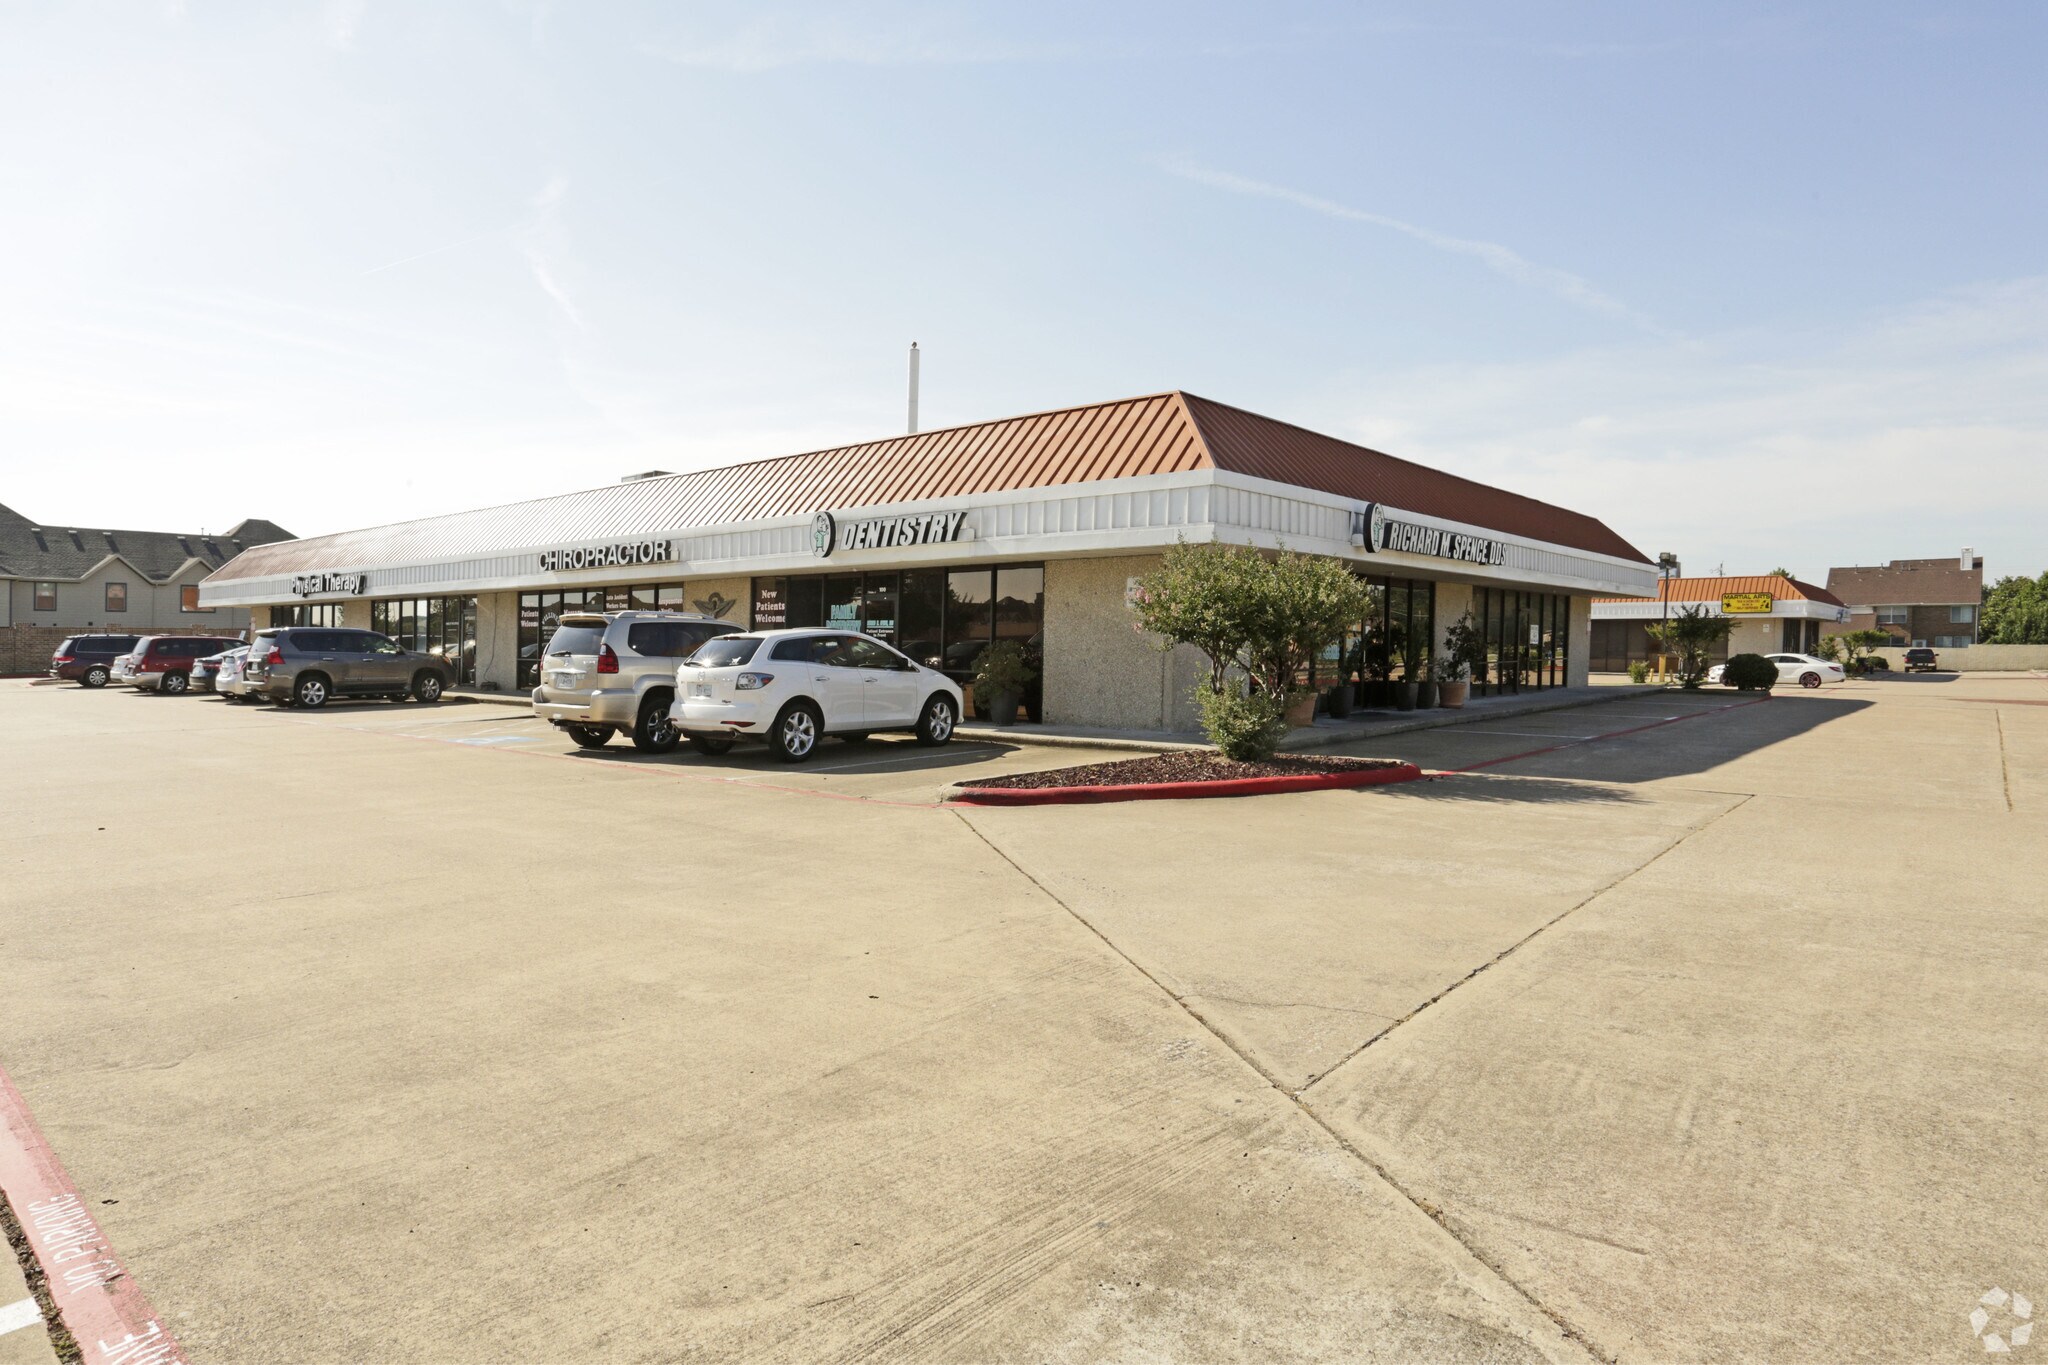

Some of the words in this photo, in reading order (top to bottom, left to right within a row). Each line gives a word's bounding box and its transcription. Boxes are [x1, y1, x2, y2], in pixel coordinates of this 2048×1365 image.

[841, 511, 964, 550] DENTISTRY
[538, 539, 668, 571] CHIROPRACTOR
[1388, 522, 1441, 557] RICHARD
[1440, 532, 1452, 558] M.
[1489, 540, 1508, 566] DDS
[292, 574, 323, 598] Physical
[324, 572, 361, 595] Therapy
[761, 590, 777, 599] New
[521, 610, 539, 618] Patients
[756, 602, 785, 611] Patients
